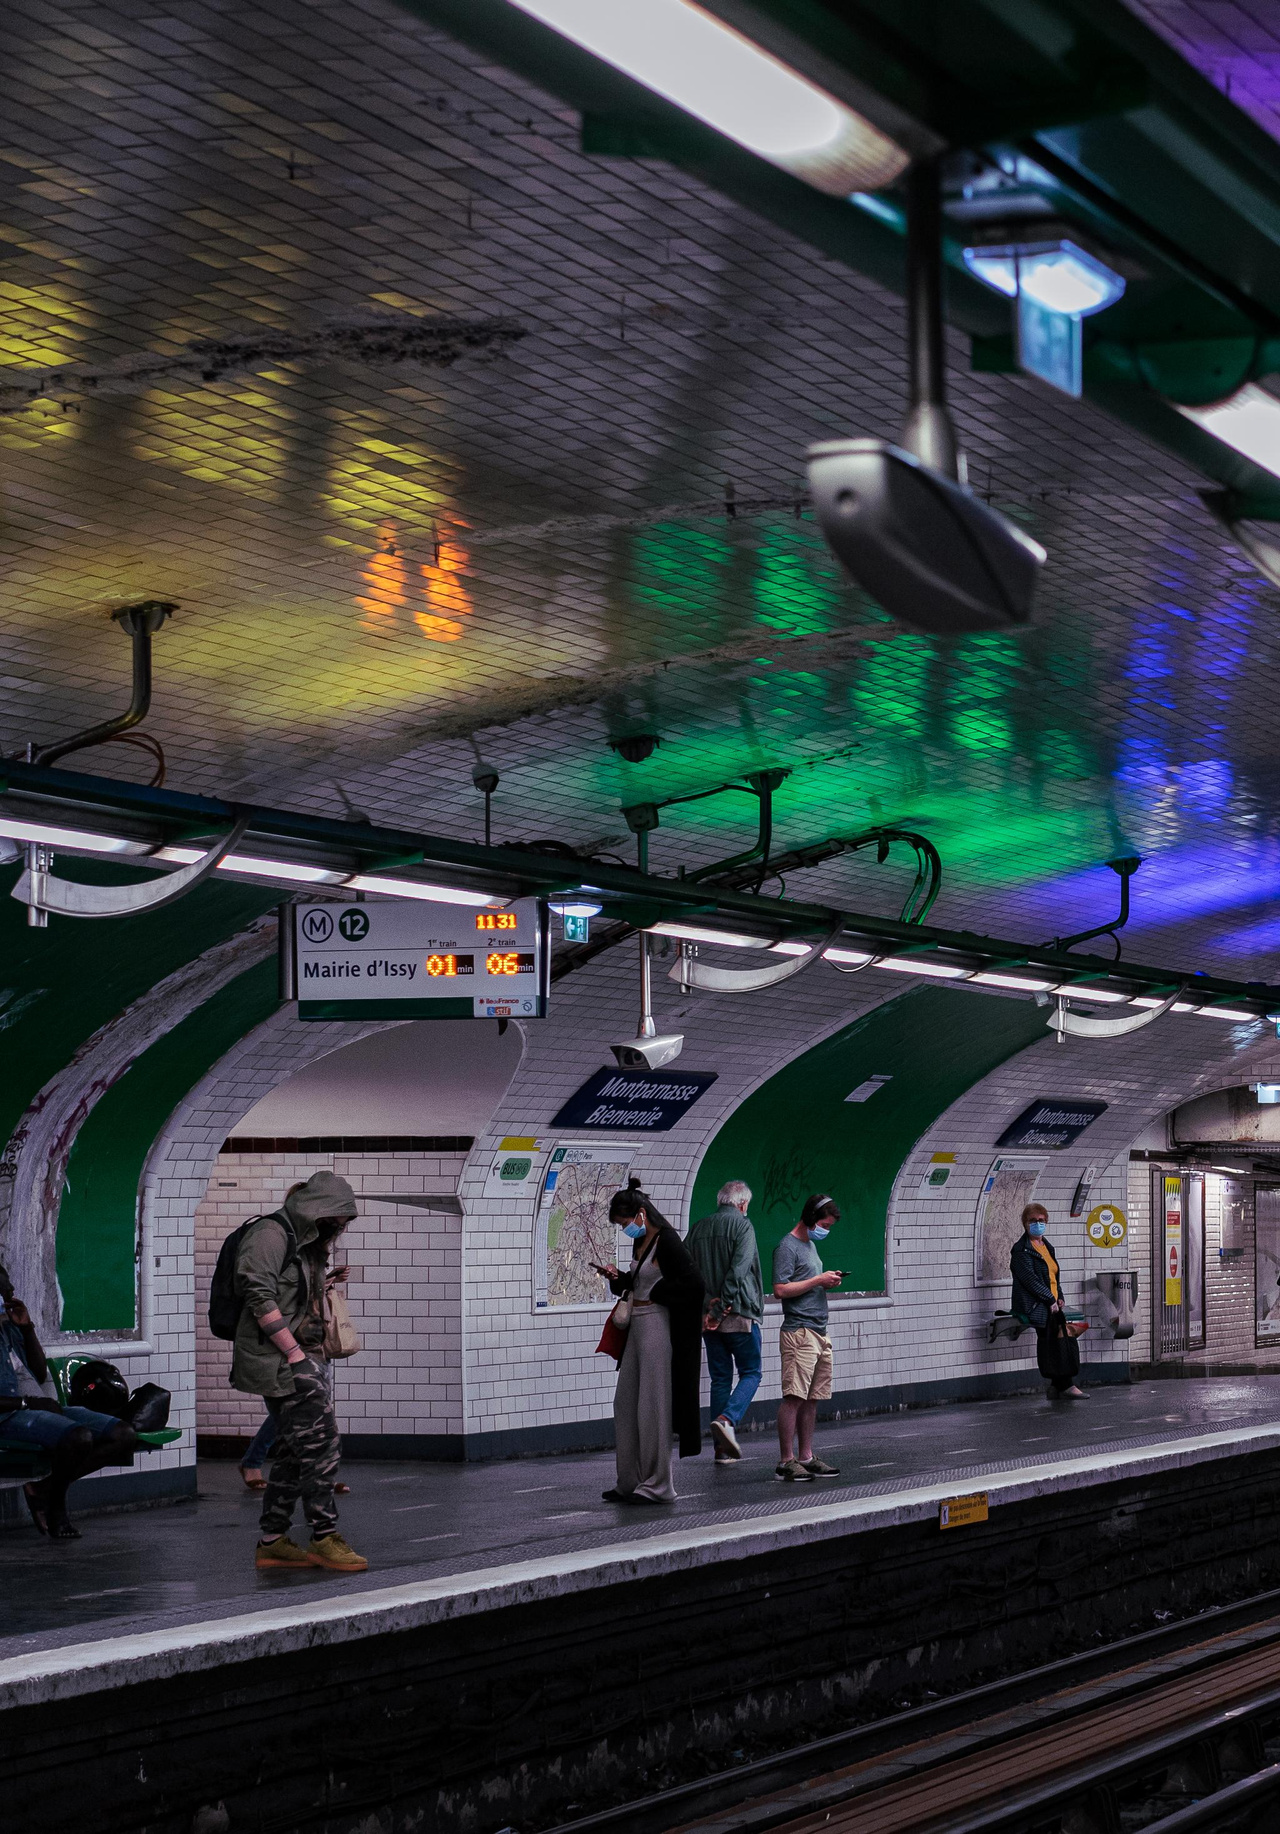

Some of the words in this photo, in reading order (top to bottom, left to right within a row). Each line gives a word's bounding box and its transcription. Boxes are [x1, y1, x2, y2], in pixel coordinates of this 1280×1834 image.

[309, 917, 327, 935] M
[341, 915, 366, 935] 12
[498, 938, 516, 946] train
[304, 960, 361, 978] Mairie
[366, 959, 417, 980] d'Issy
[426, 954, 457, 977] 01
[457, 964, 474, 973] min
[486, 953, 519, 975] 06
[597, 1076, 699, 1103] Montparnasse
[584, 1104, 663, 1126] Bienvenüe
[502, 1162, 516, 1175] BUS
